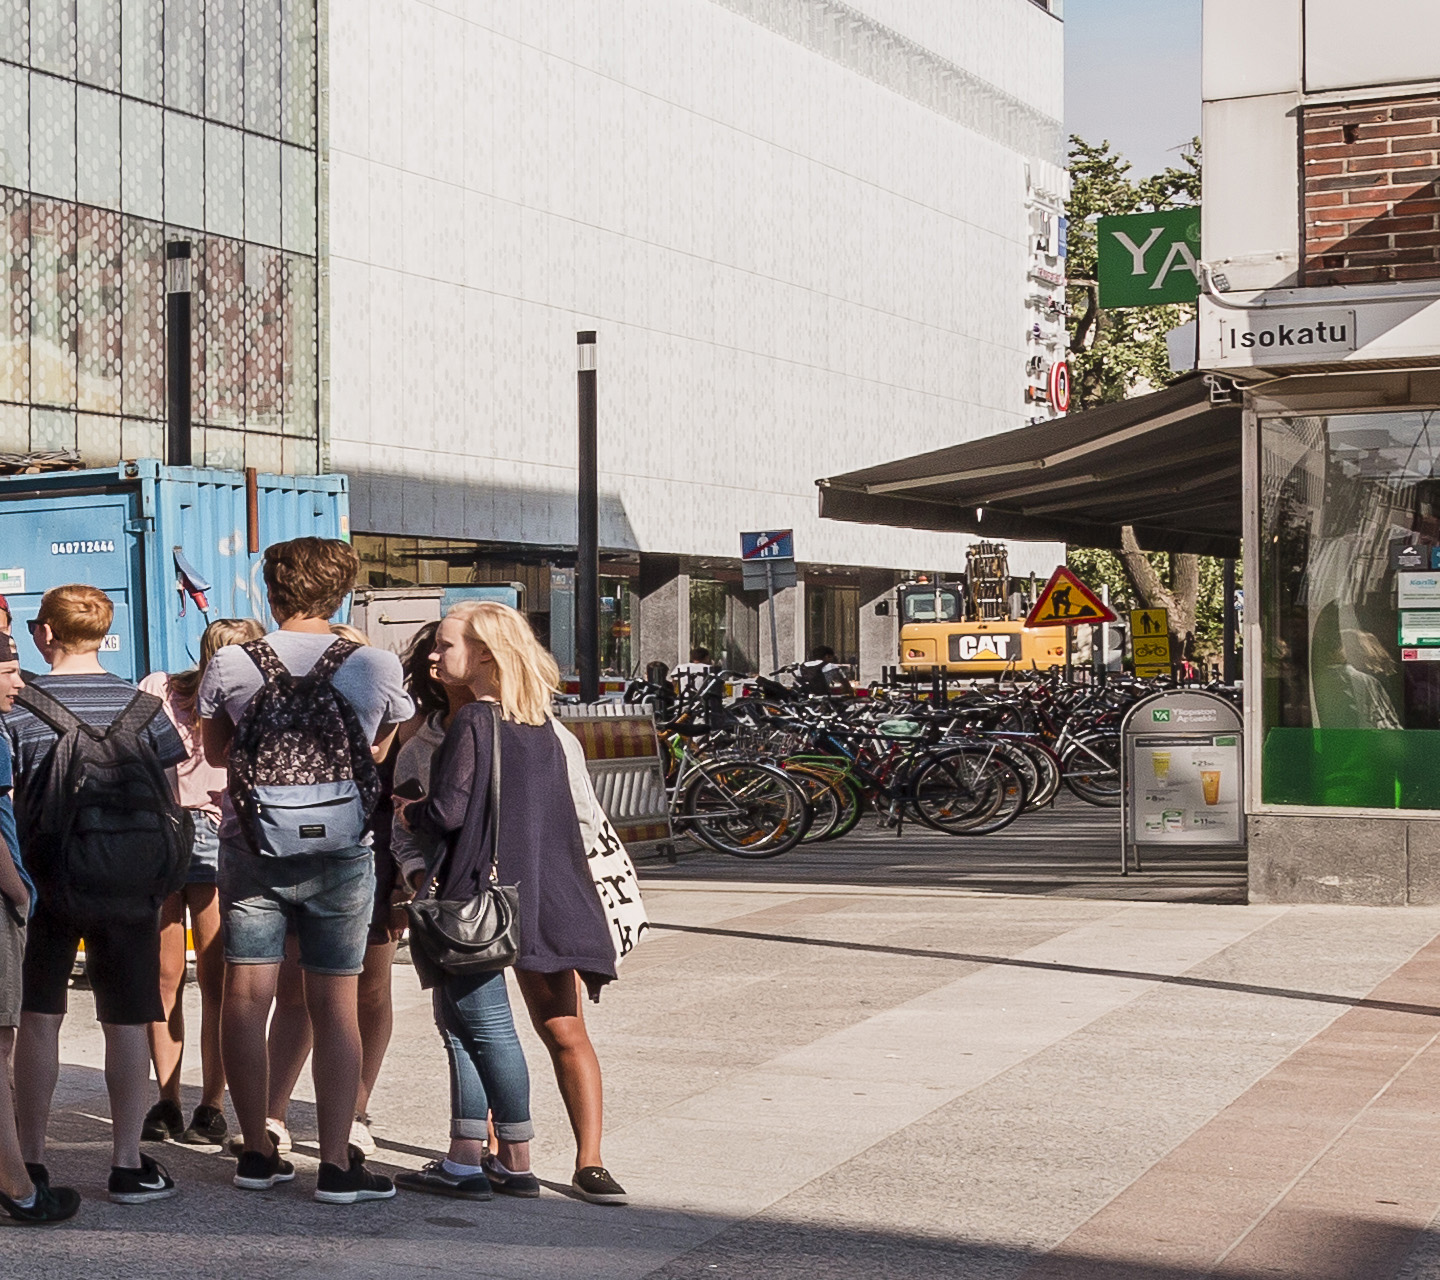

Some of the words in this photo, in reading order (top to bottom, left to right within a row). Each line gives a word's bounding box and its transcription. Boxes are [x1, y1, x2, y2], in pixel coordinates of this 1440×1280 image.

[1111, 227, 1201, 289] YA
[1230, 321, 1347, 349] Isokatu
[51, 541, 114, 554] 040712444
[105, 636, 116, 649] KG
[958, 635, 1010, 660] CAT
